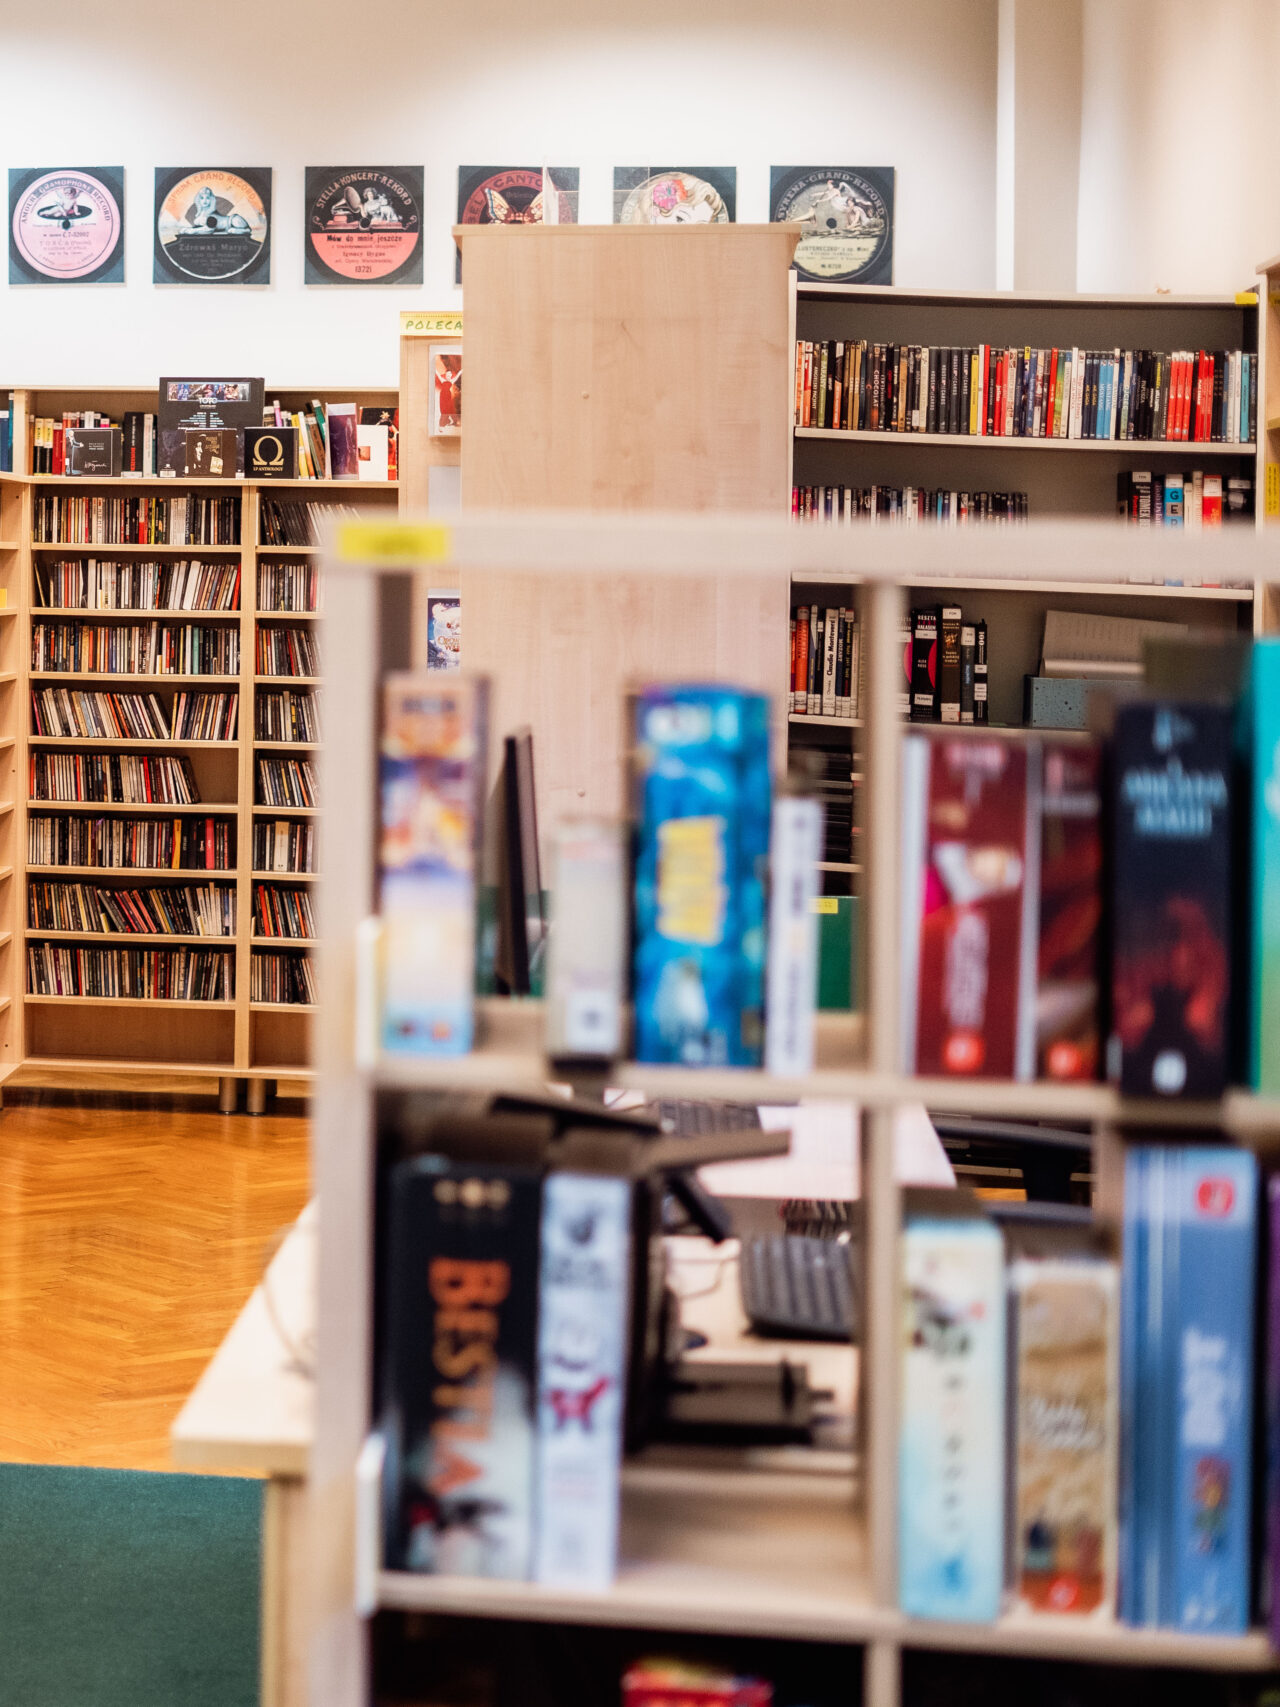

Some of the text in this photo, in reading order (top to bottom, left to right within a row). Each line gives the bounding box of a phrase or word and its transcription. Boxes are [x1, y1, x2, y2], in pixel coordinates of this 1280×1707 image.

[194, 173, 224, 183] GRAND
[227, 175, 257, 201] RECORD
[316, 172, 412, 208] STELLA KONCERT REKORD
[809, 171, 850, 181] GRAND
[853, 179, 885, 215] RECORD
[93, 191, 110, 221] RECORD
[327, 234, 342, 242] Mów
[377, 235, 403, 243] jeszcze
[199, 397, 218, 405] TOTO
[1139, 495, 1151, 518] TOMEK
[428, 1257, 511, 1496] BESTIA
